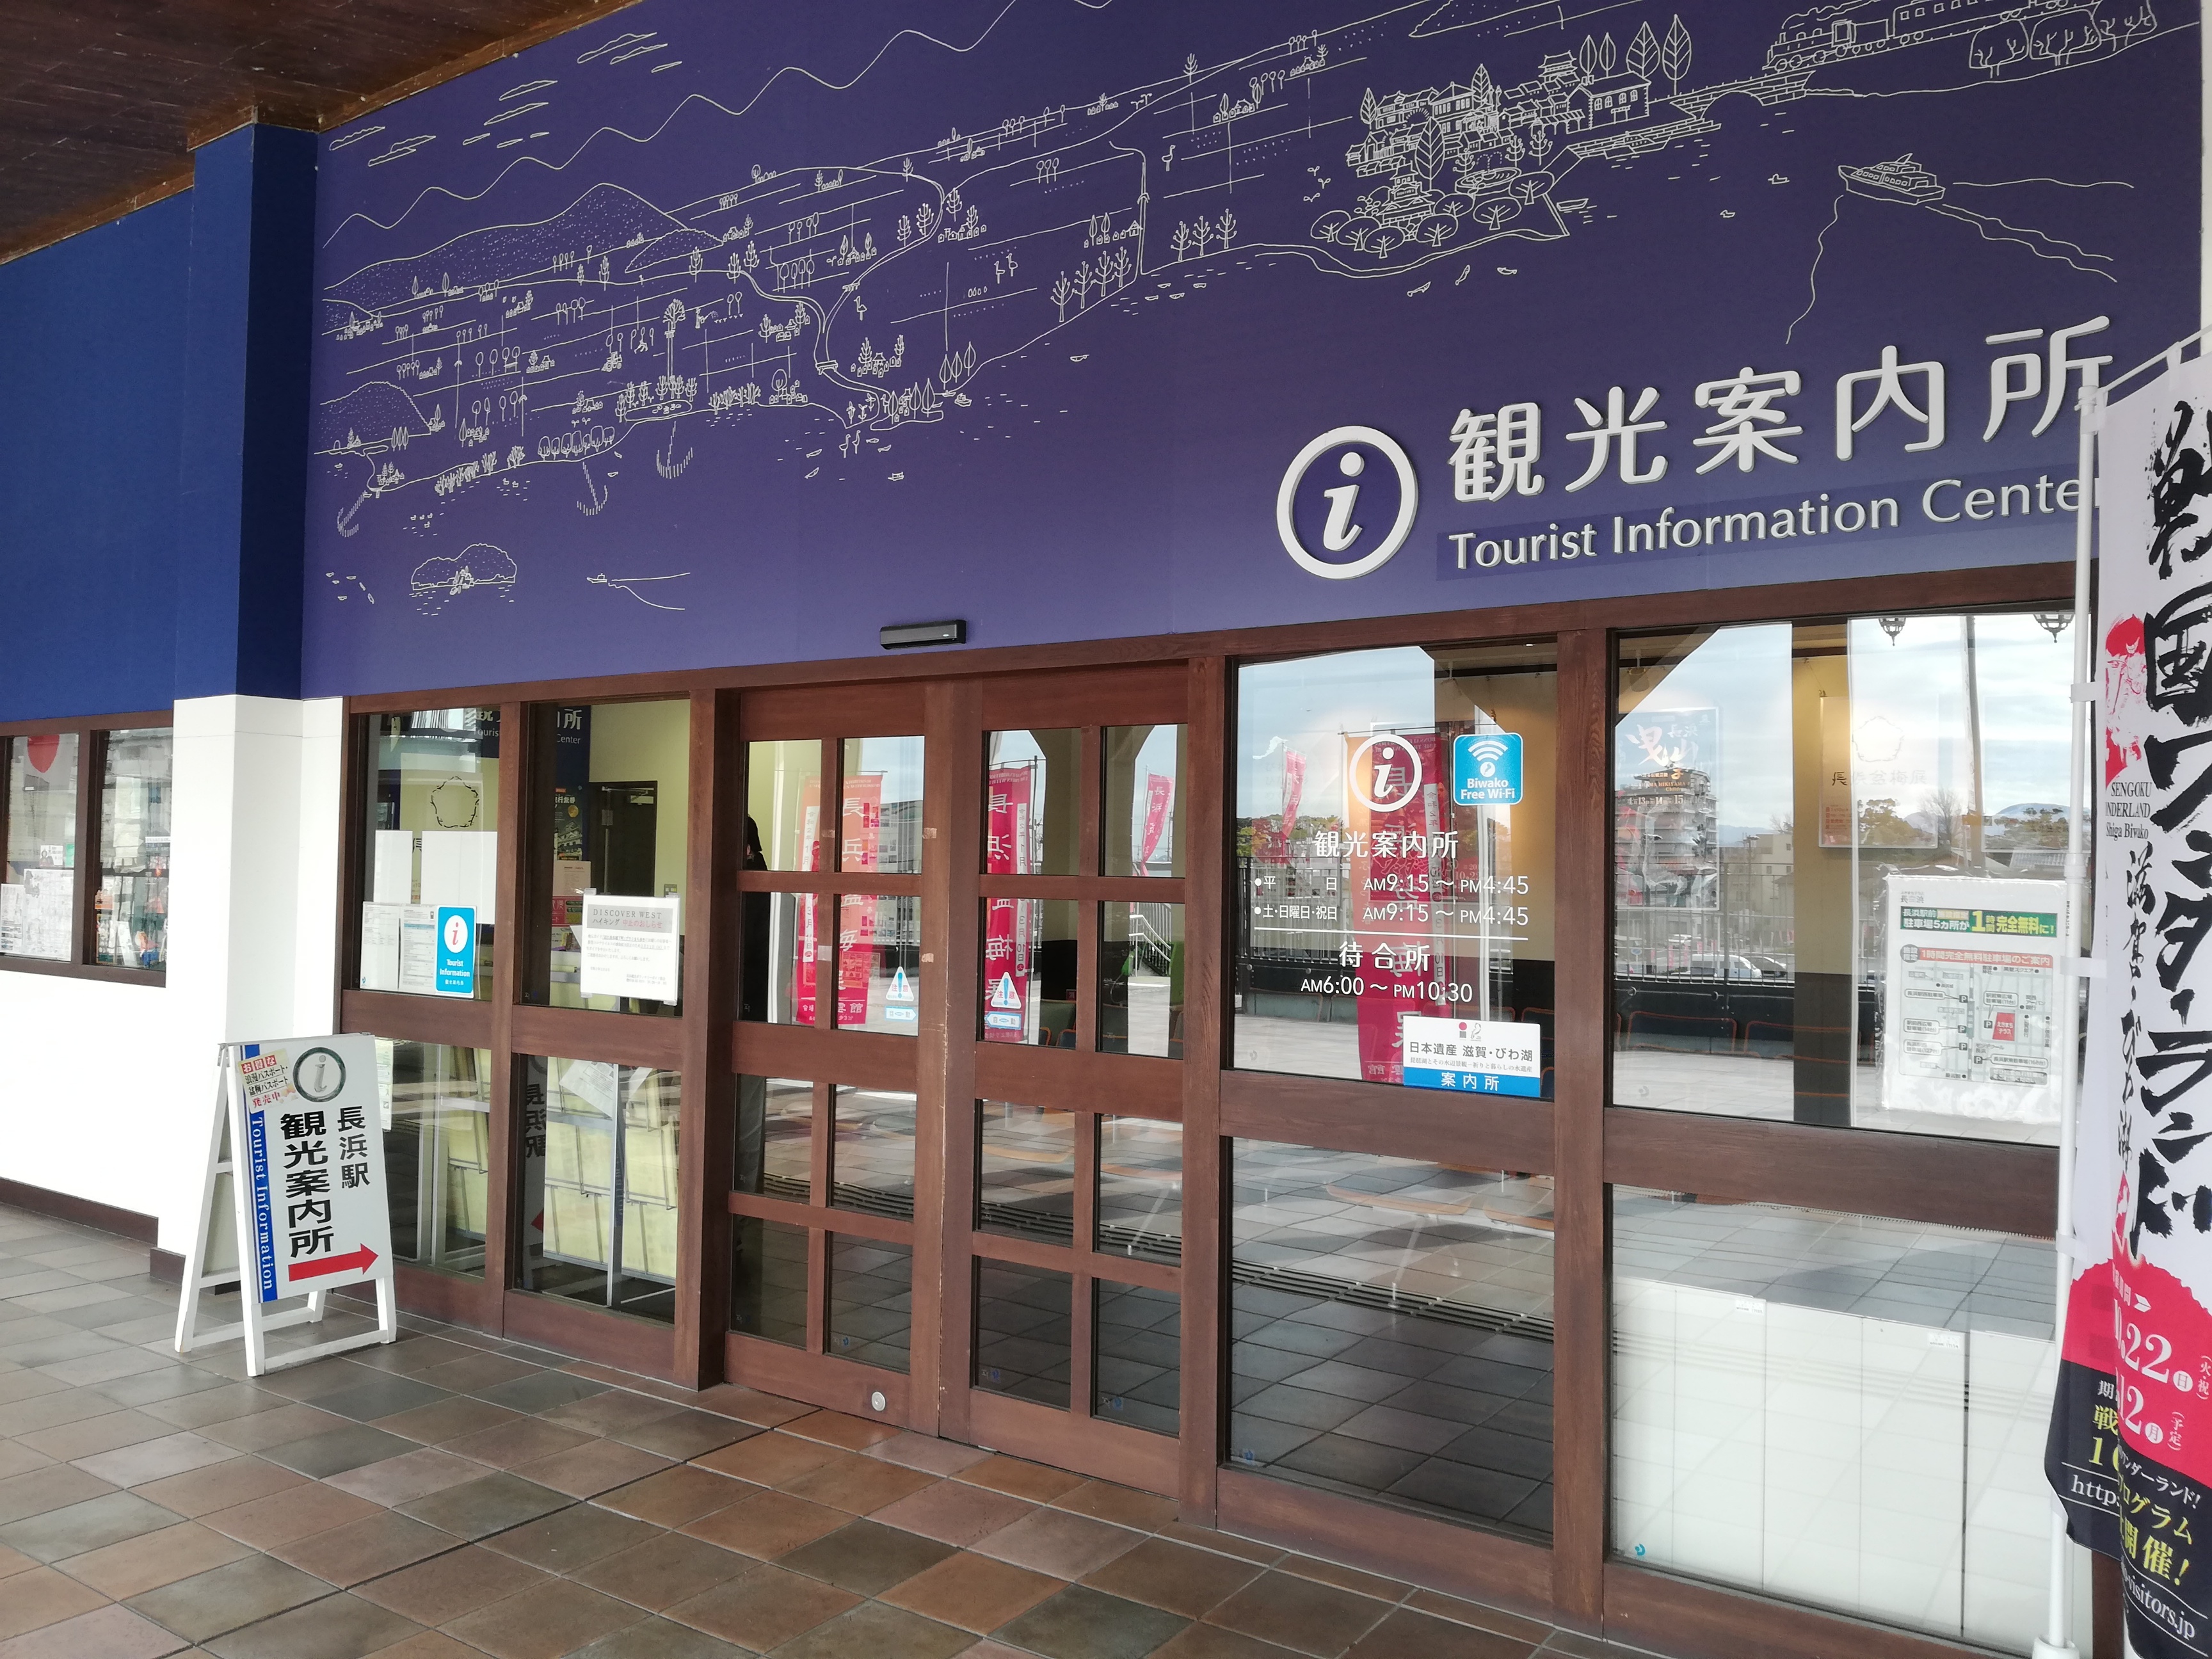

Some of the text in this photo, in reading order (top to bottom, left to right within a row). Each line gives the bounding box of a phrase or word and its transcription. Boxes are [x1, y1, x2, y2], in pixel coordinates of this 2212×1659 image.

[1447, 316, 2114, 504] 観光案内所
[1448, 525, 1598, 570] Tourist
[1613, 494, 1900, 553] Information
[1466, 778, 1509, 789] Biwako
[2110, 781, 2152, 797] SENGOKU
[1460, 789, 1515, 800] Free Wi-Fi
[2124, 822, 2149, 840] Biwako
[1314, 830, 1459, 860] 観光案内所
[1363, 873, 1429, 893] AM9:15
[1459, 875, 1528, 895] PM4:45
[593, 908, 636, 918] DISCOVER
[1363, 902, 1429, 922] AM9:15
[1459, 906, 1528, 926] PM4:45
[1903, 908, 1936, 918] 長浜駅前
[593, 918, 663, 929] ハイキング 中止のおしらせ
[446, 959, 464, 967] Tourist
[1338, 941, 1431, 972] 待合所
[1921, 949, 2050, 966] 1時間完全無料駐車場のご案内
[439, 968, 470, 977] Information
[1301, 975, 1365, 997] AM6:00
[1393, 979, 1473, 1003] PM10:30
[1410, 1041, 1533, 1062] 日本遺産 滋賀・びわ湖
[243, 1056, 276, 1073] お得な
[1441, 1072, 1500, 1092] 案内所
[252, 1091, 280, 1109] 発売中
[337, 1105, 370, 1189] 長浜駅
[280, 1110, 335, 1258] 観光案内所
[250, 1116, 274, 1290] Tourist Information
